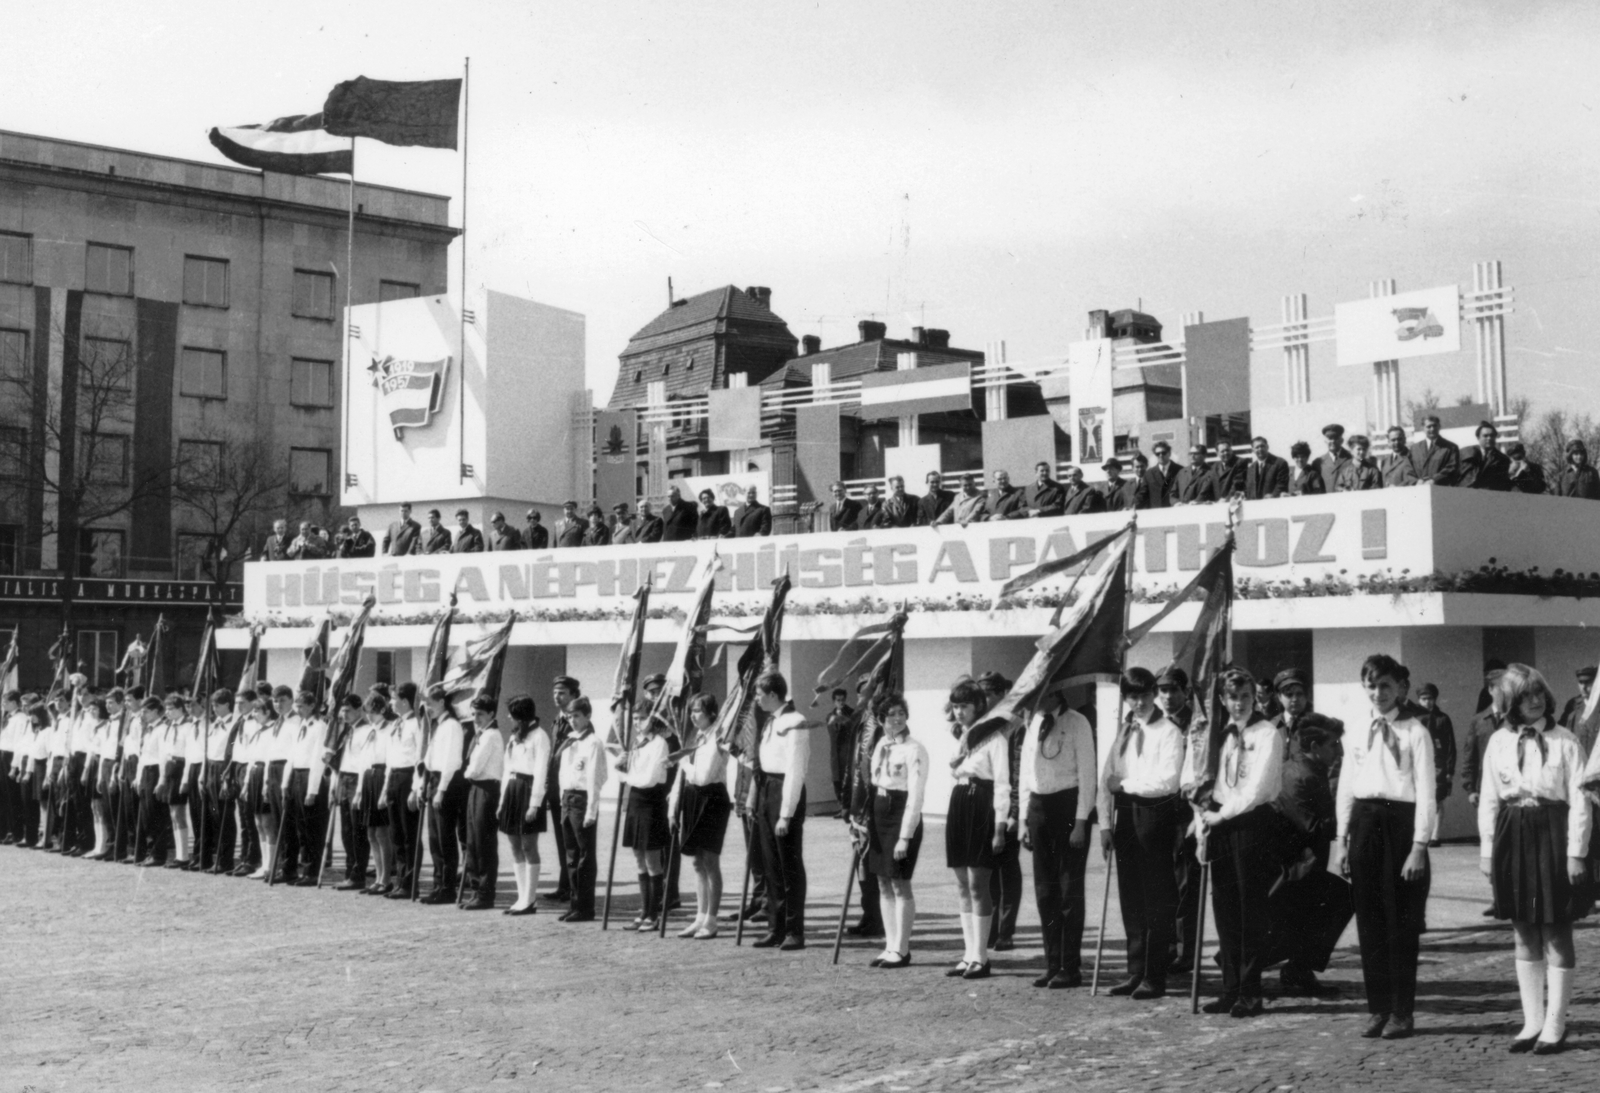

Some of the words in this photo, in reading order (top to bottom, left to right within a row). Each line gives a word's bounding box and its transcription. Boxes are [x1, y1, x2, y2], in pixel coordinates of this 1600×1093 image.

[389, 360, 415, 376] 1919
[384, 375, 411, 393] 1957
[454, 566, 491, 602] A
[498, 554, 698, 602] NÉPHEZ
[928, 540, 980, 584] A
[4, 580, 84, 597] IALISA
